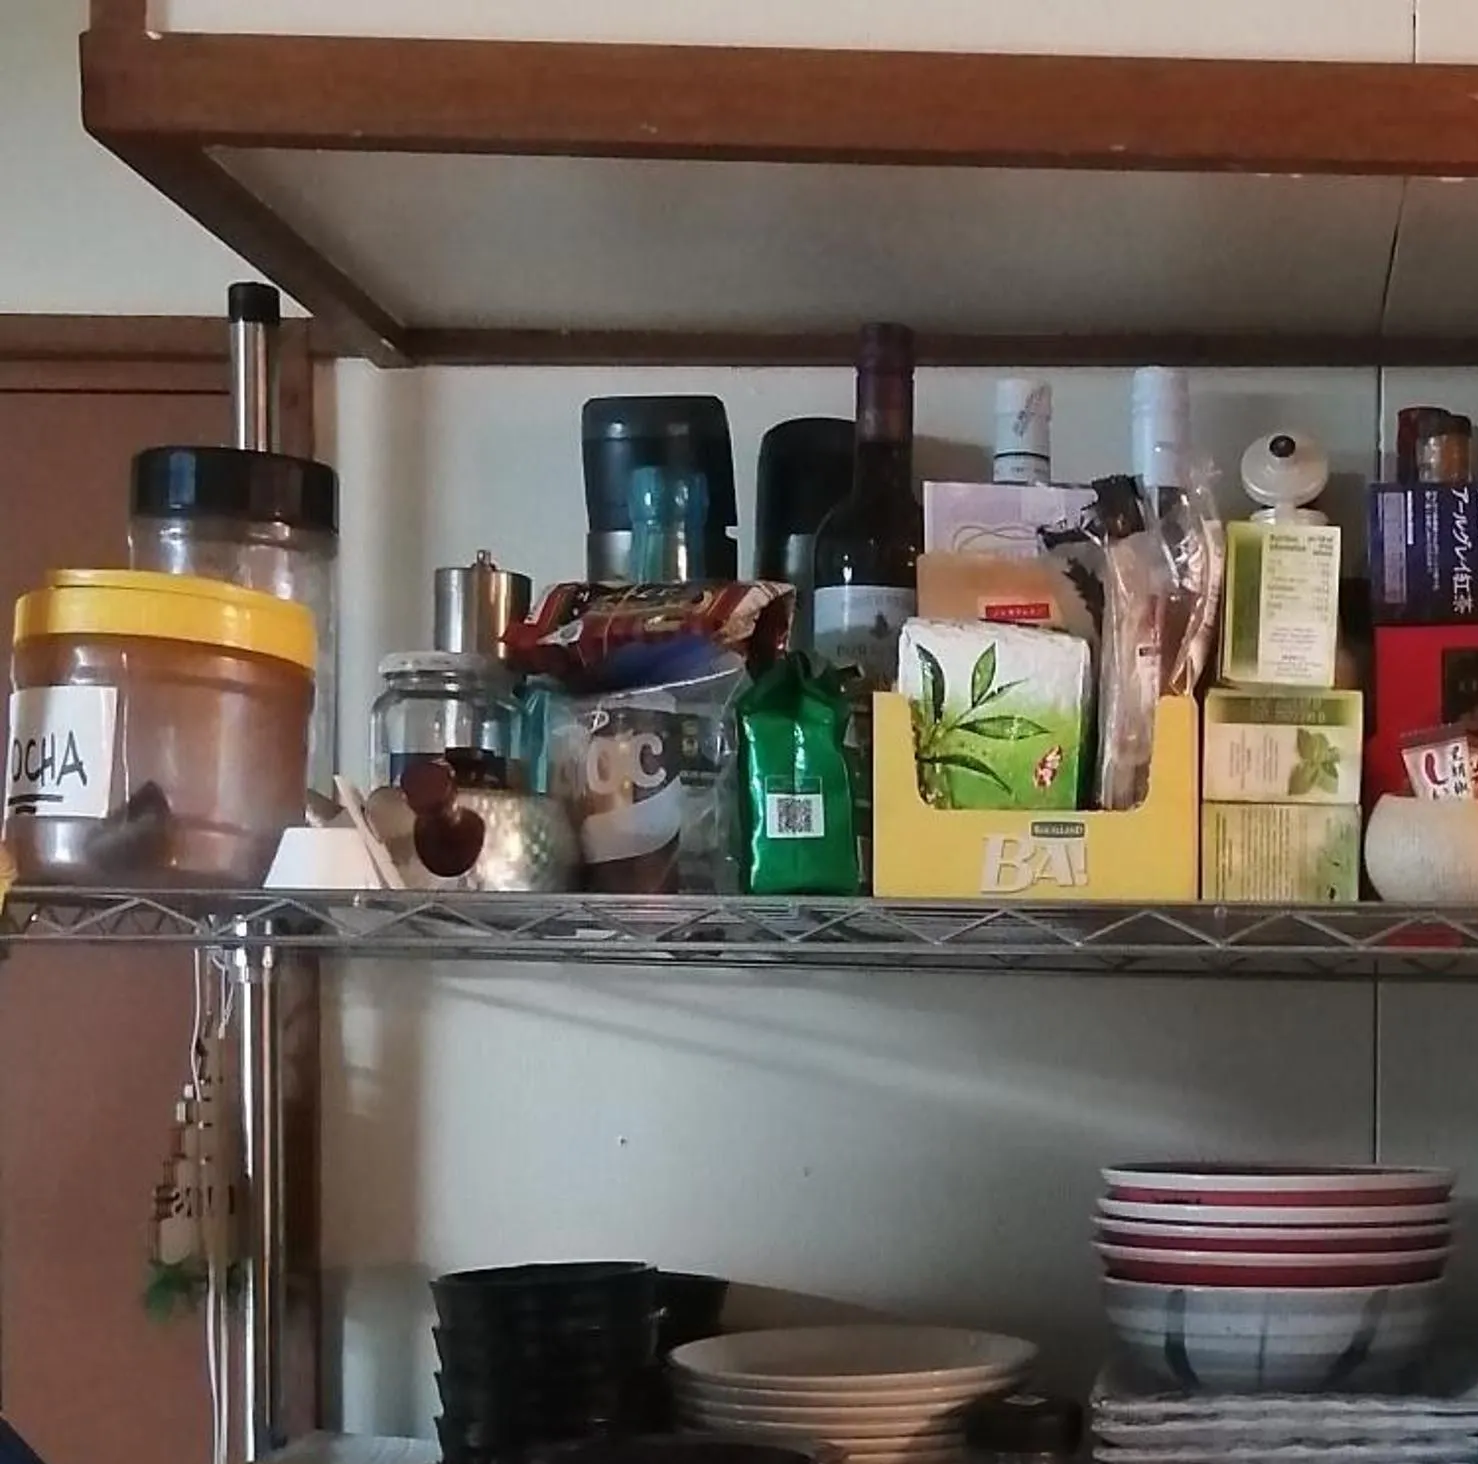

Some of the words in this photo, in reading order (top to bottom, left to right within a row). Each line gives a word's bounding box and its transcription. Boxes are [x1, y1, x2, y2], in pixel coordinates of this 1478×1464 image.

[1451, 485, 1475, 615] アールグレイ紅茶
[981, 836, 1088, 894] BA!
